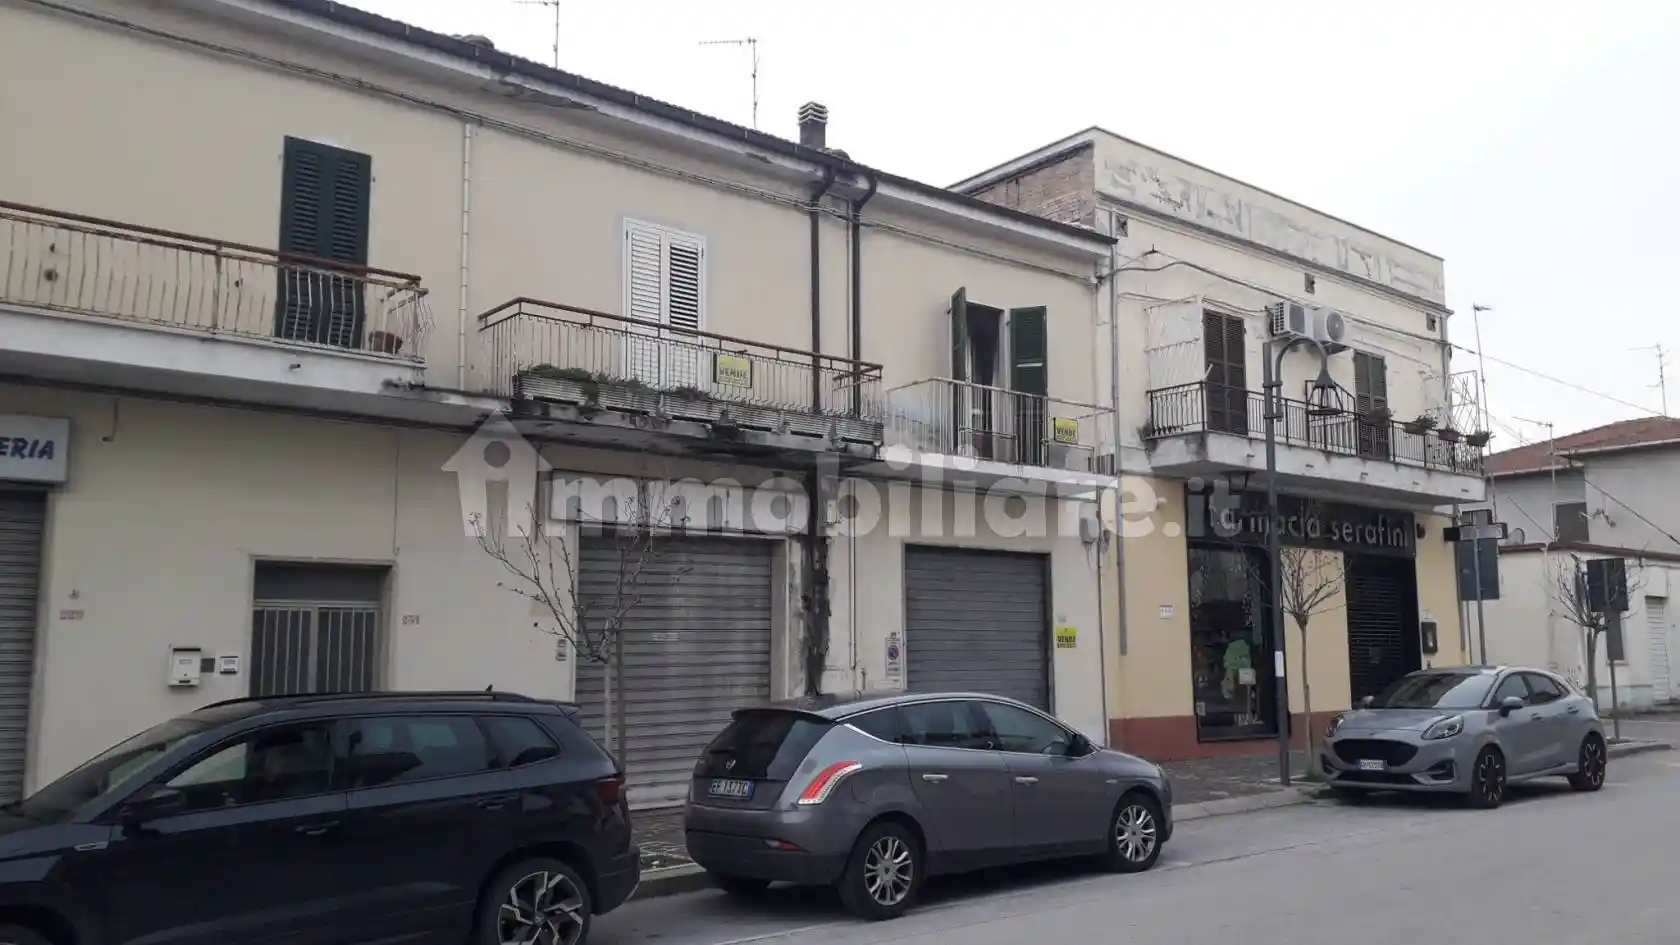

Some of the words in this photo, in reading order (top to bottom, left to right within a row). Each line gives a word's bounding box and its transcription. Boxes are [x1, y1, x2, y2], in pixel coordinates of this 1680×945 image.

[1056, 427, 1076, 437] VENDE
[0, 436, 54, 460] ERIA
[1332, 513, 1408, 547] serafini
